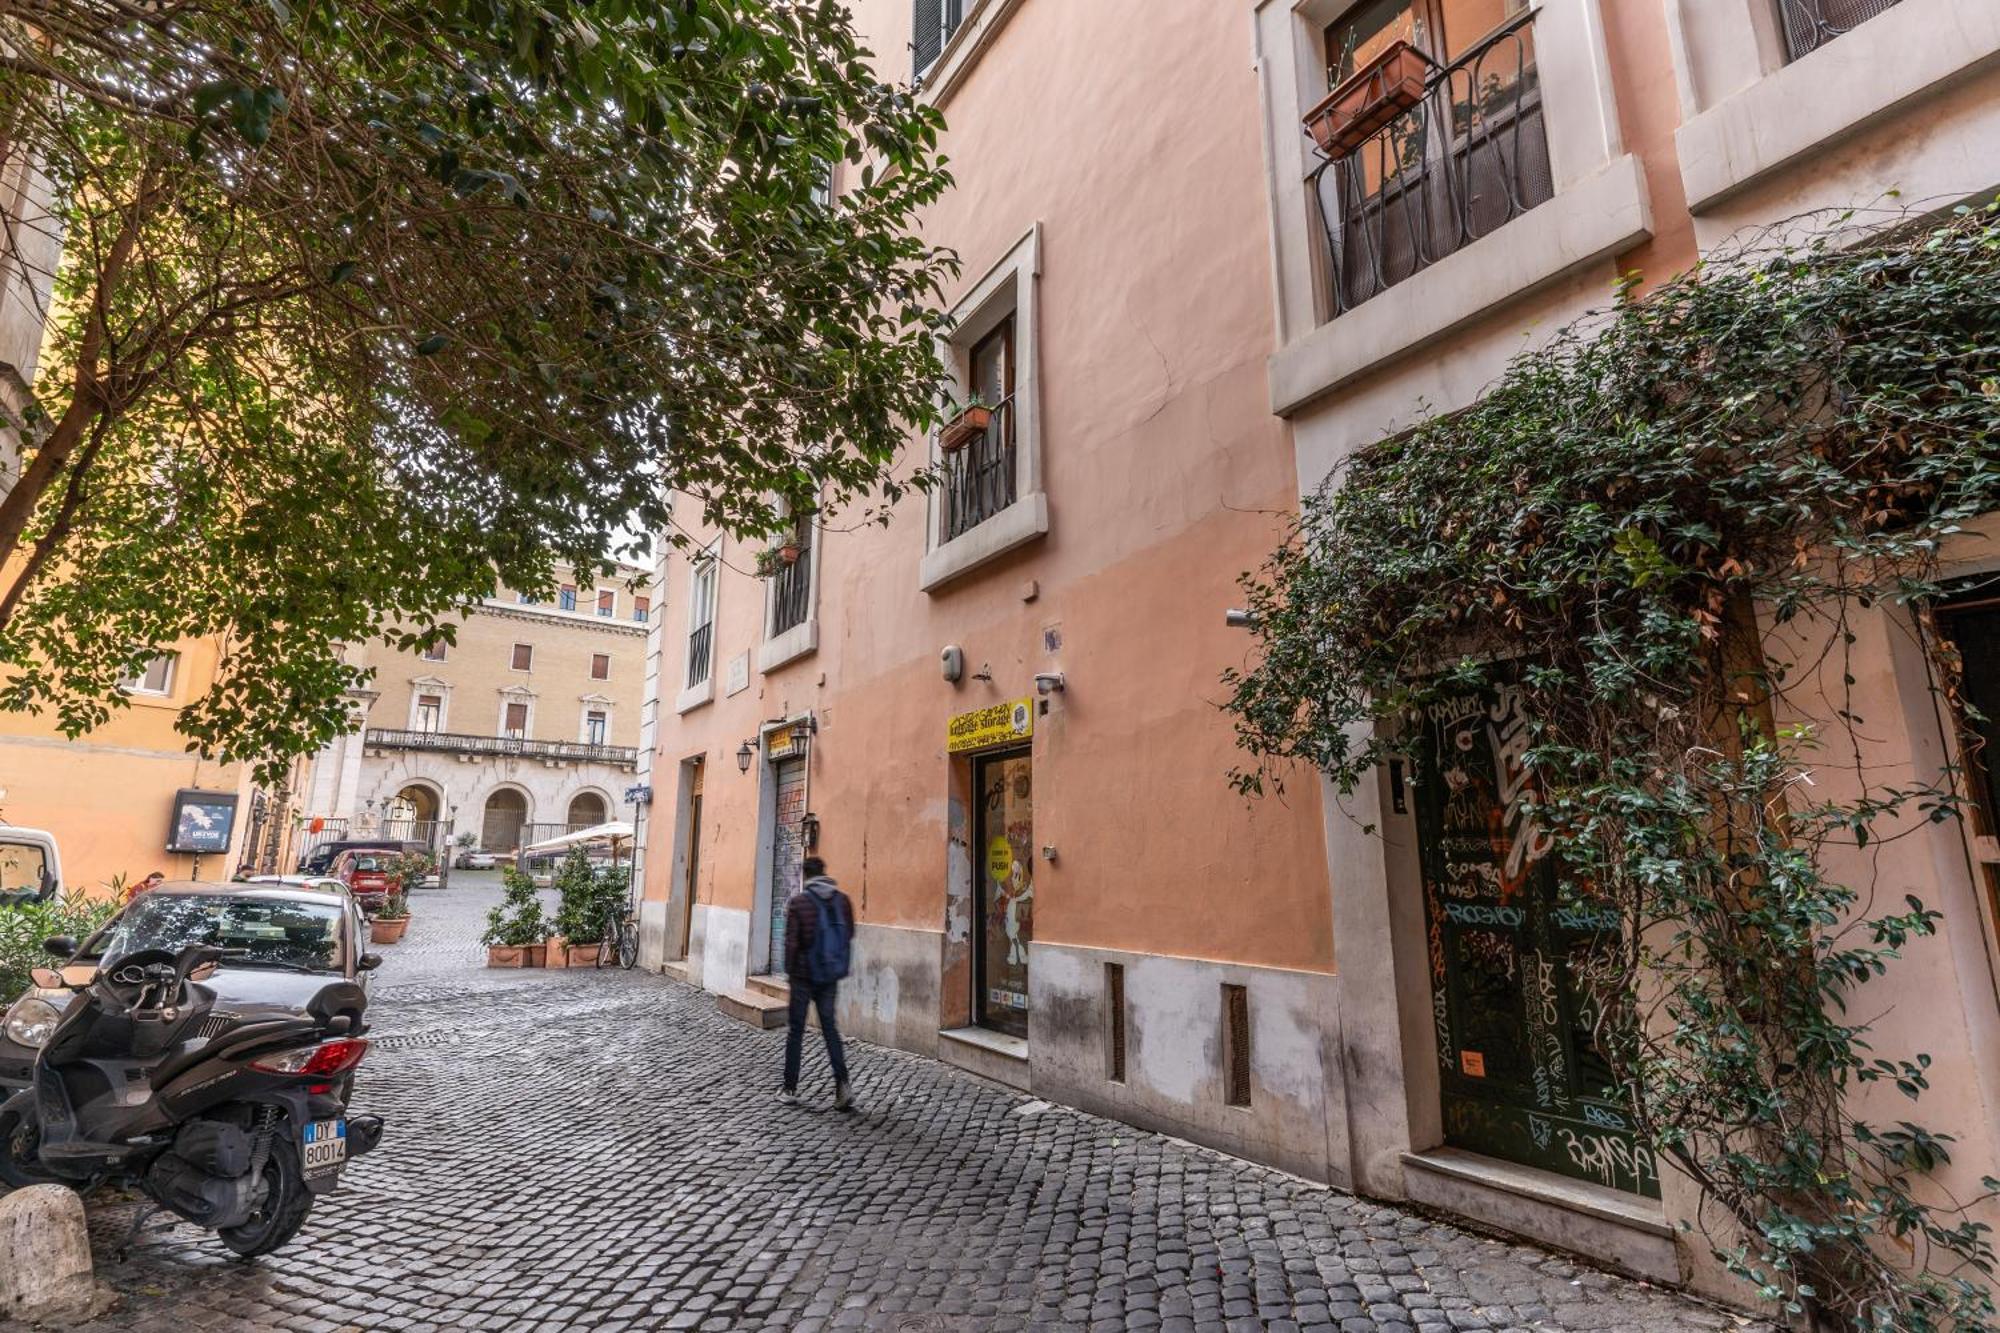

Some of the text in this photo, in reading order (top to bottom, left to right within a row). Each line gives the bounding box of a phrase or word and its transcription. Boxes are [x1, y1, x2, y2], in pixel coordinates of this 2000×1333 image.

[992, 862, 1009, 871] PUSH
[316, 1121, 330, 1140] DY
[306, 1141, 344, 1165] 80014
